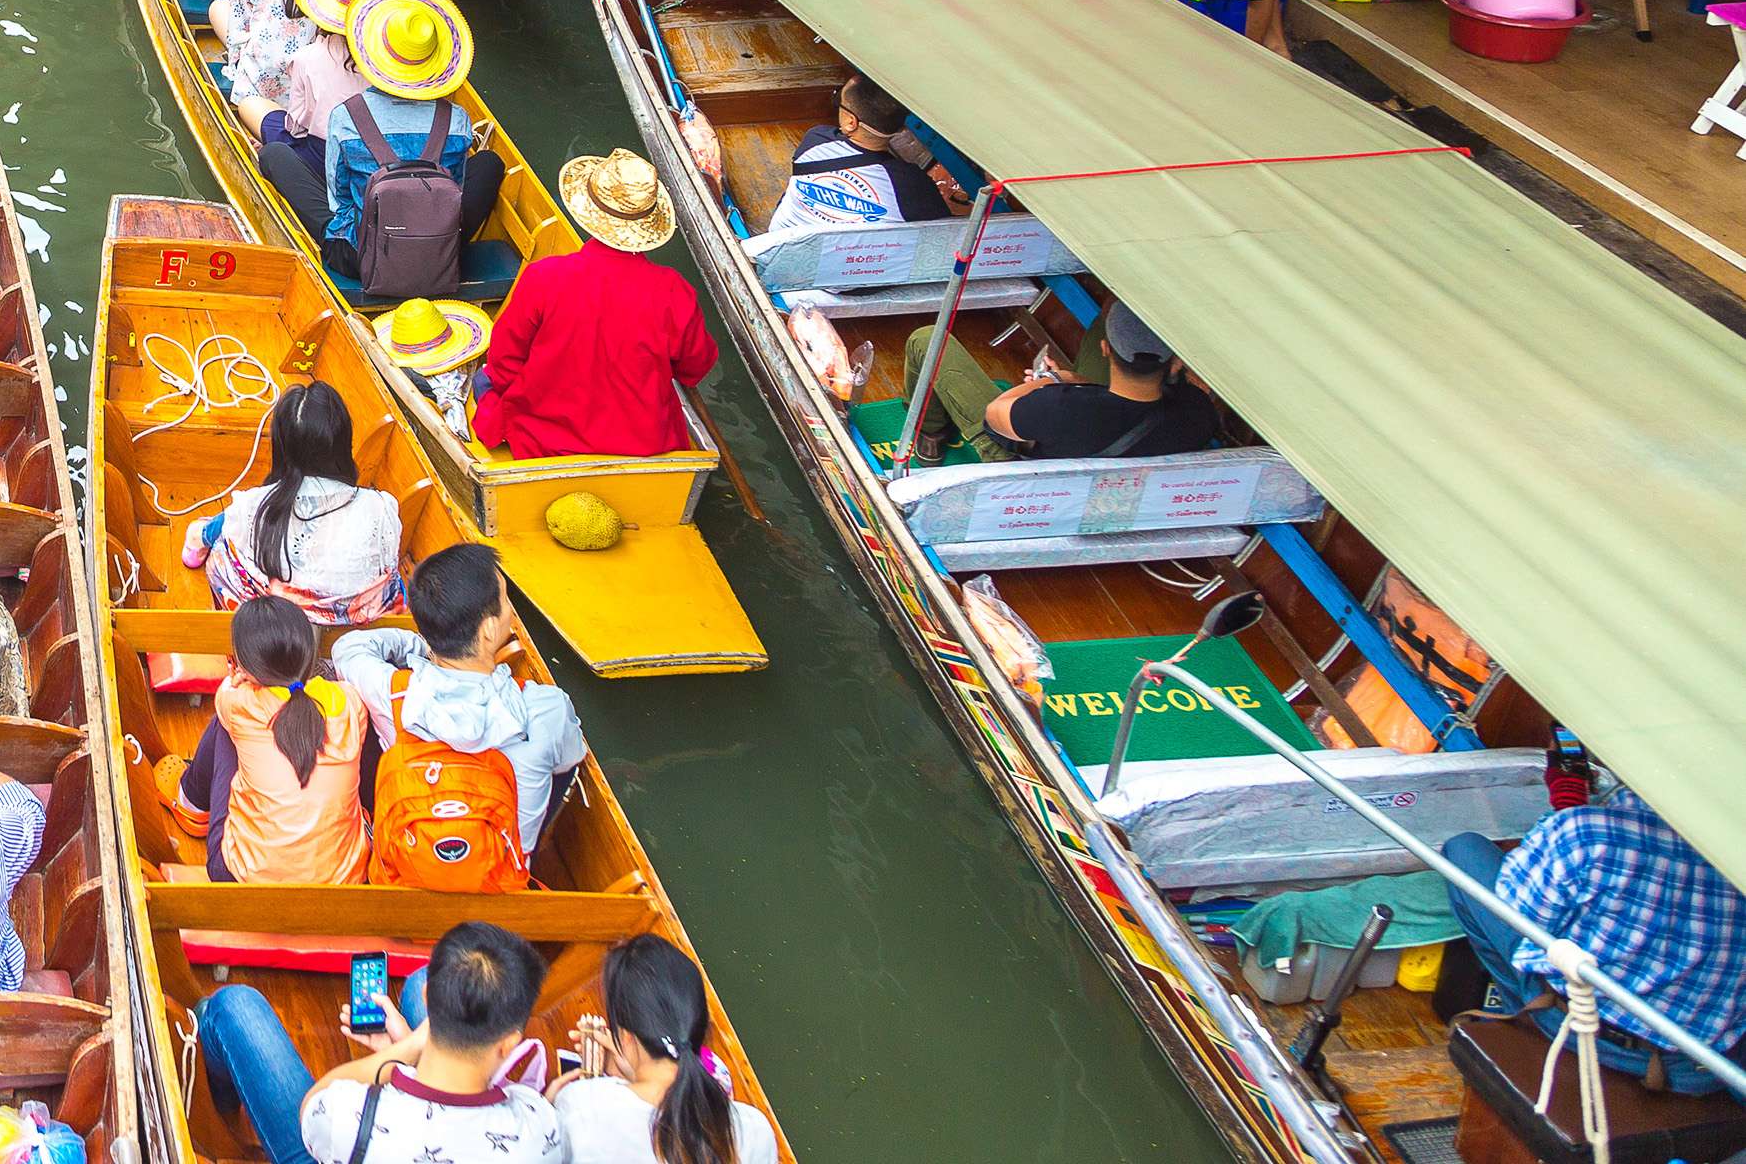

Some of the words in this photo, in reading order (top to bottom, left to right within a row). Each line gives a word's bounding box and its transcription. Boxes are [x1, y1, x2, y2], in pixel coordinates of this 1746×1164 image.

[811, 186, 843, 207] THE
[843, 195, 875, 212] WALL
[209, 251, 237, 280] 9
[1046, 685, 1261, 717] WELCOME
